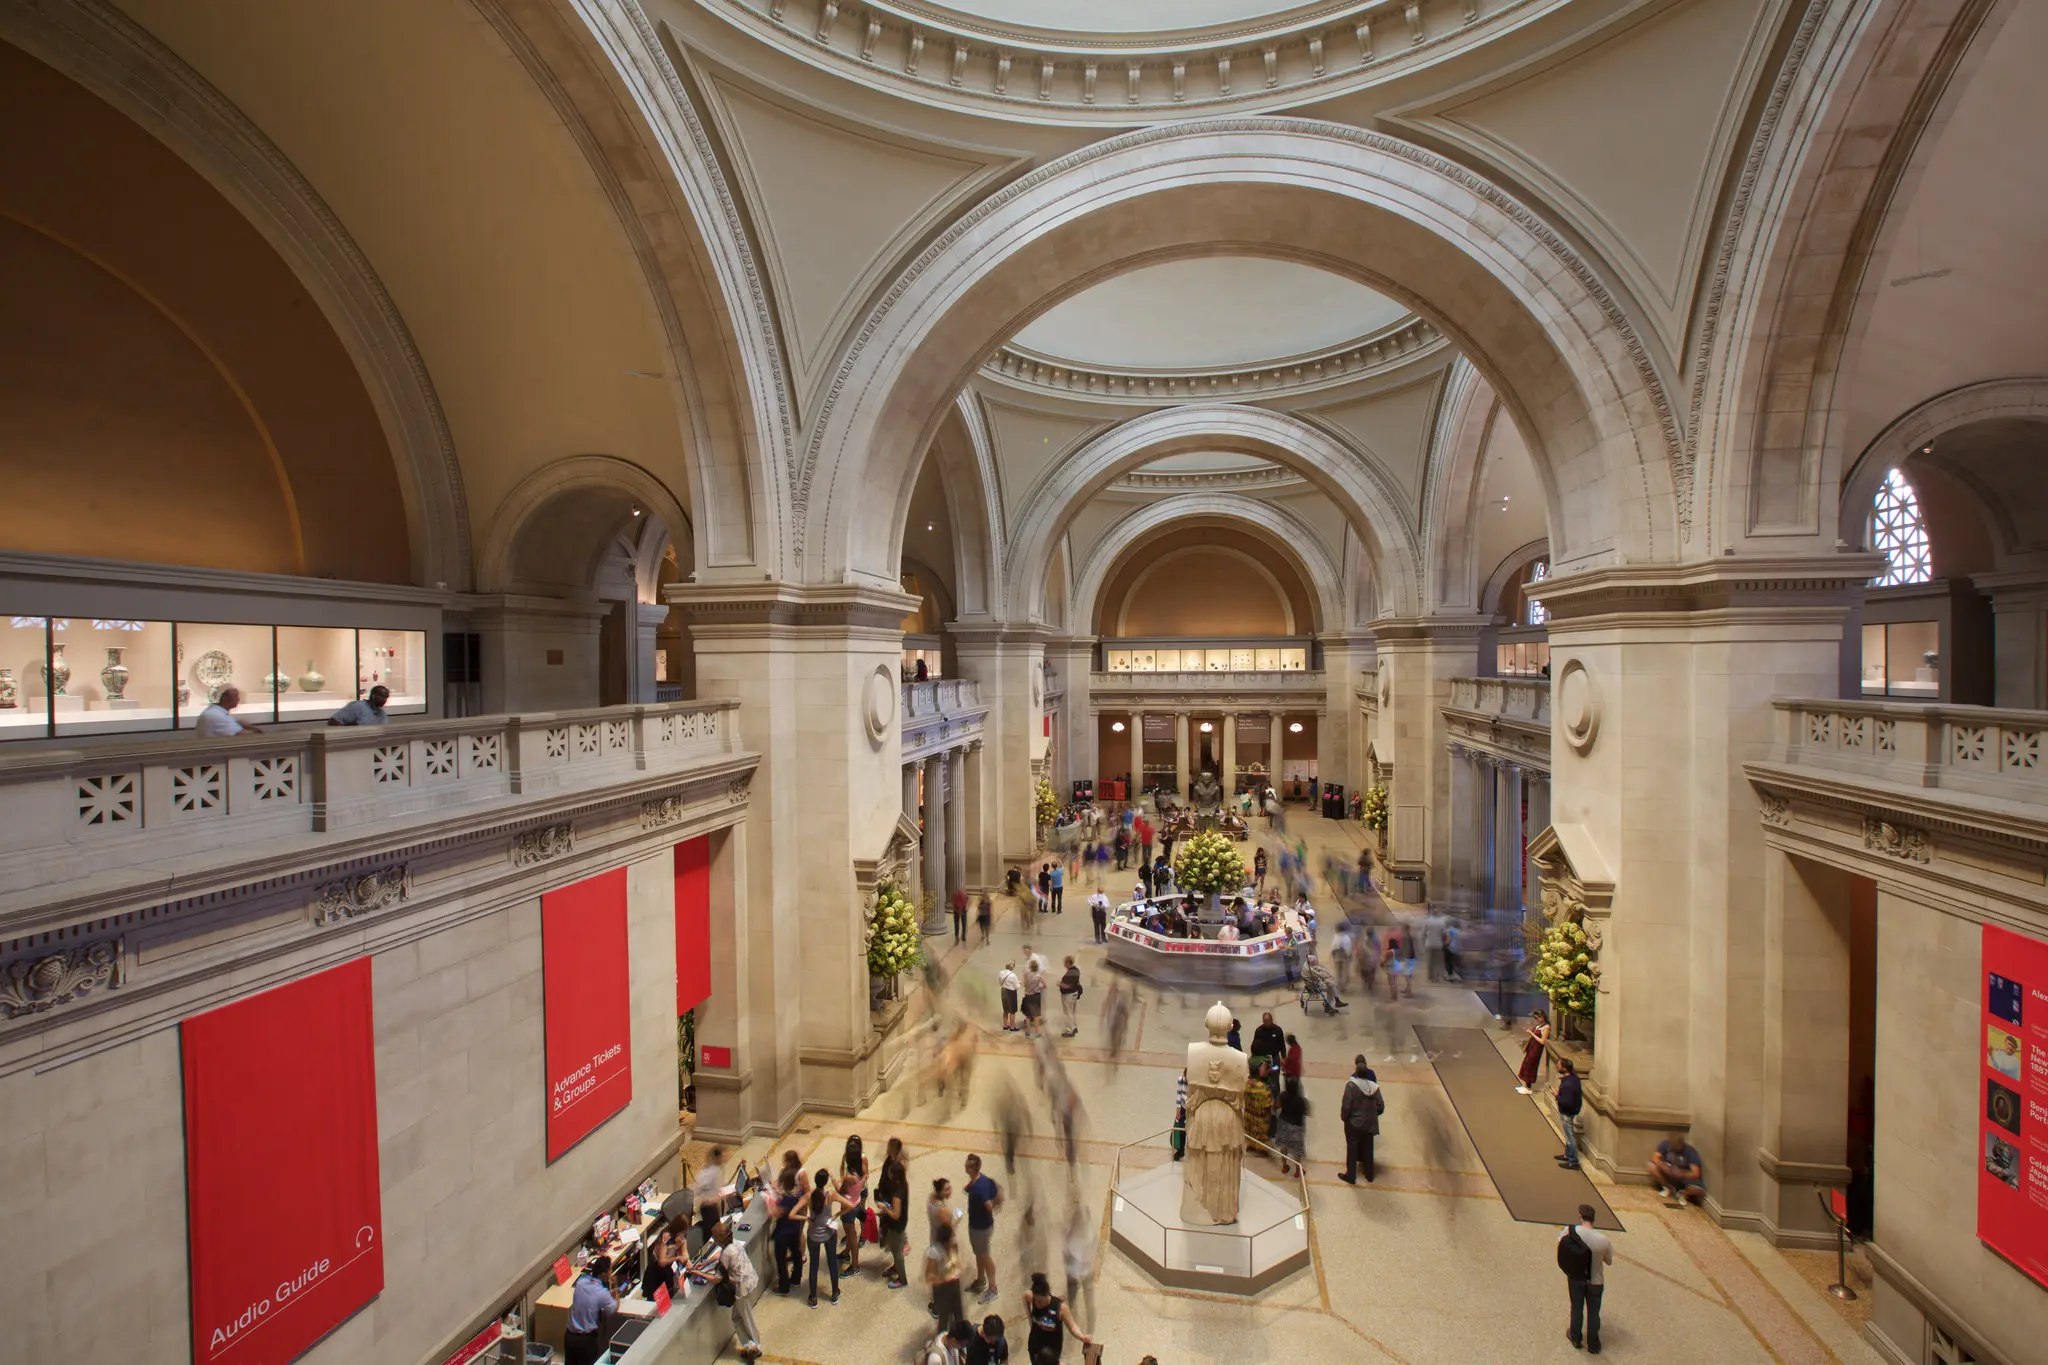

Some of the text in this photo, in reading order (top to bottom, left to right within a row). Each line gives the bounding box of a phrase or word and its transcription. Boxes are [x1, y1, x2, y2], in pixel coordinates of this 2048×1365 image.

[554, 1044, 621, 1096] Advance Tickets
[2031, 1044, 2047, 1058] The
[554, 1075, 596, 1112] & Groups
[210, 1258, 330, 1351] Audio Guide
